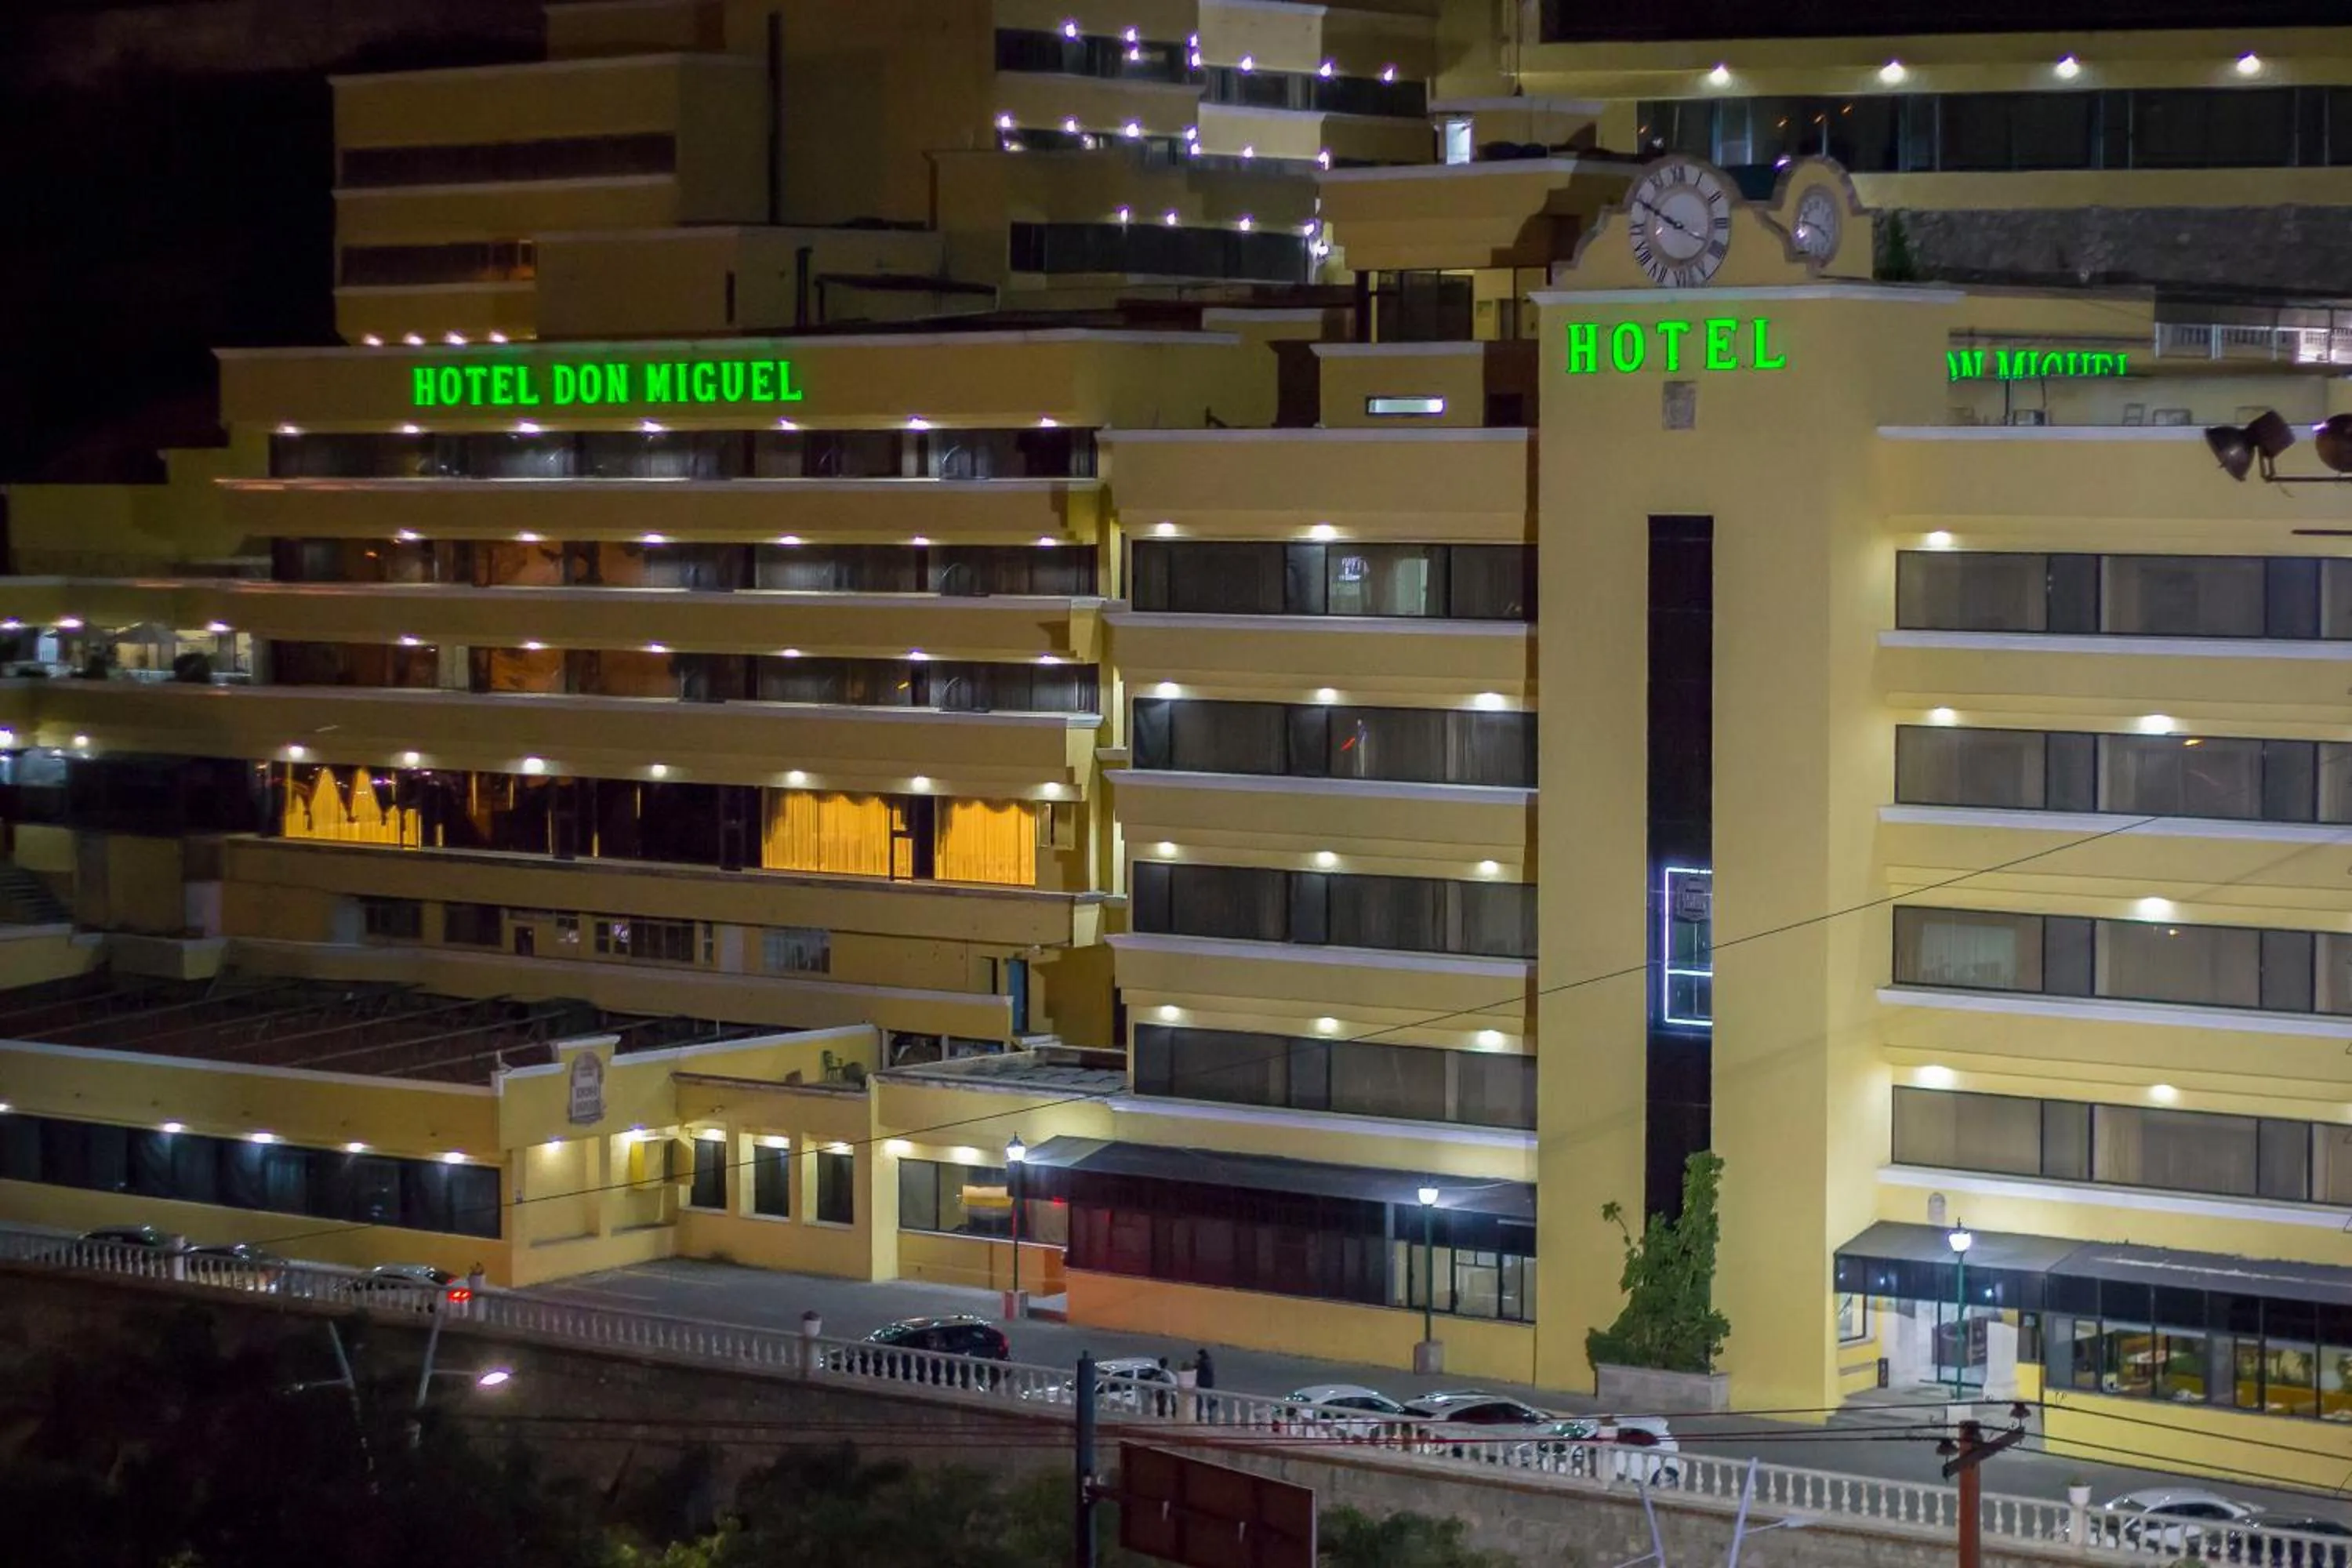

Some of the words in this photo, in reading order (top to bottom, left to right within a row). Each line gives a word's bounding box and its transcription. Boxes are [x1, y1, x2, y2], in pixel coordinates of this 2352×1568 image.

[1567, 317, 1786, 374] HOTEL
[412, 364, 541, 406] HOTEL
[552, 361, 630, 405] DON
[644, 360, 804, 403] MIGUEL
